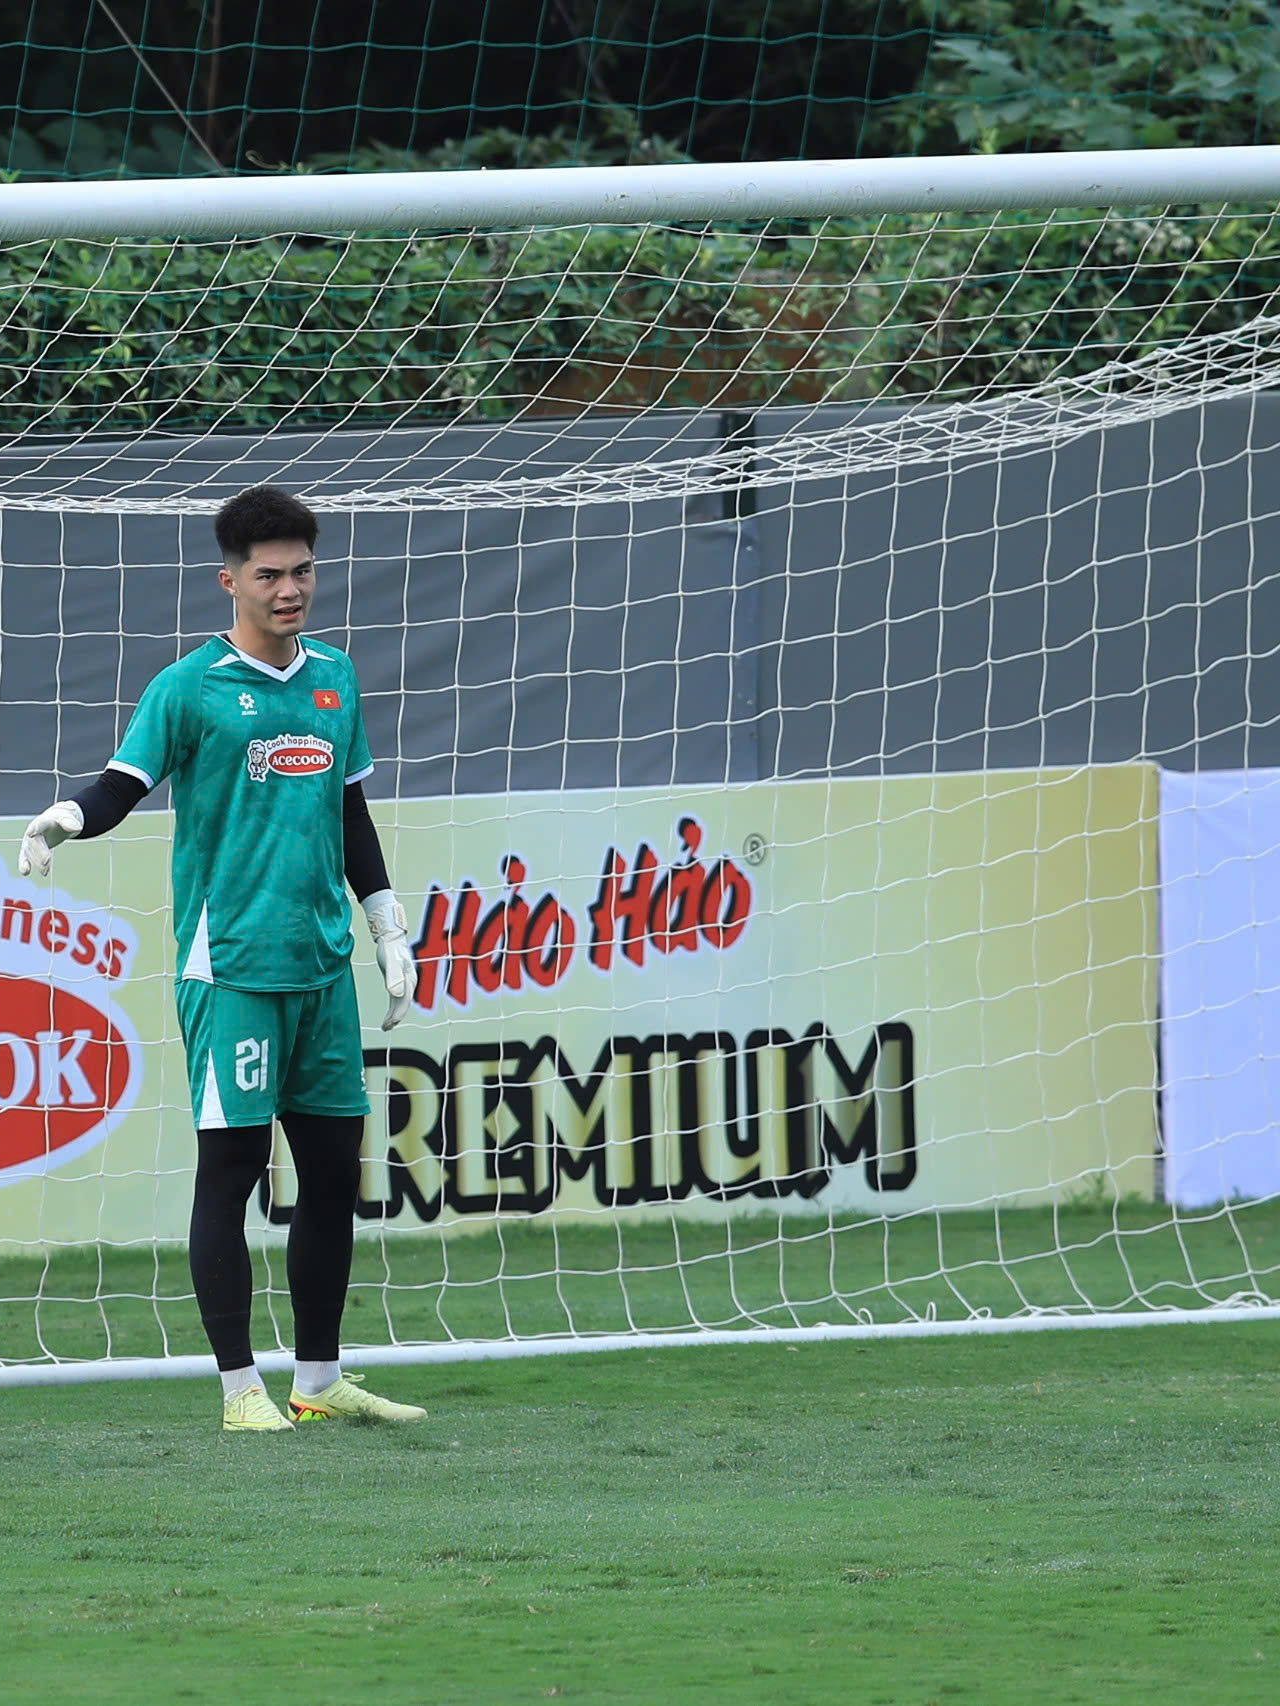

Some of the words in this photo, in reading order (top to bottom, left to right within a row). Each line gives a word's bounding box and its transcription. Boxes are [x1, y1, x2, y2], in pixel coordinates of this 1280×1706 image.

[266, 736, 286, 750] Cook
[287, 736, 331, 751] happiness
[235, 1036, 269, 1093] 21
[260, 1021, 918, 1226] REMIUM
